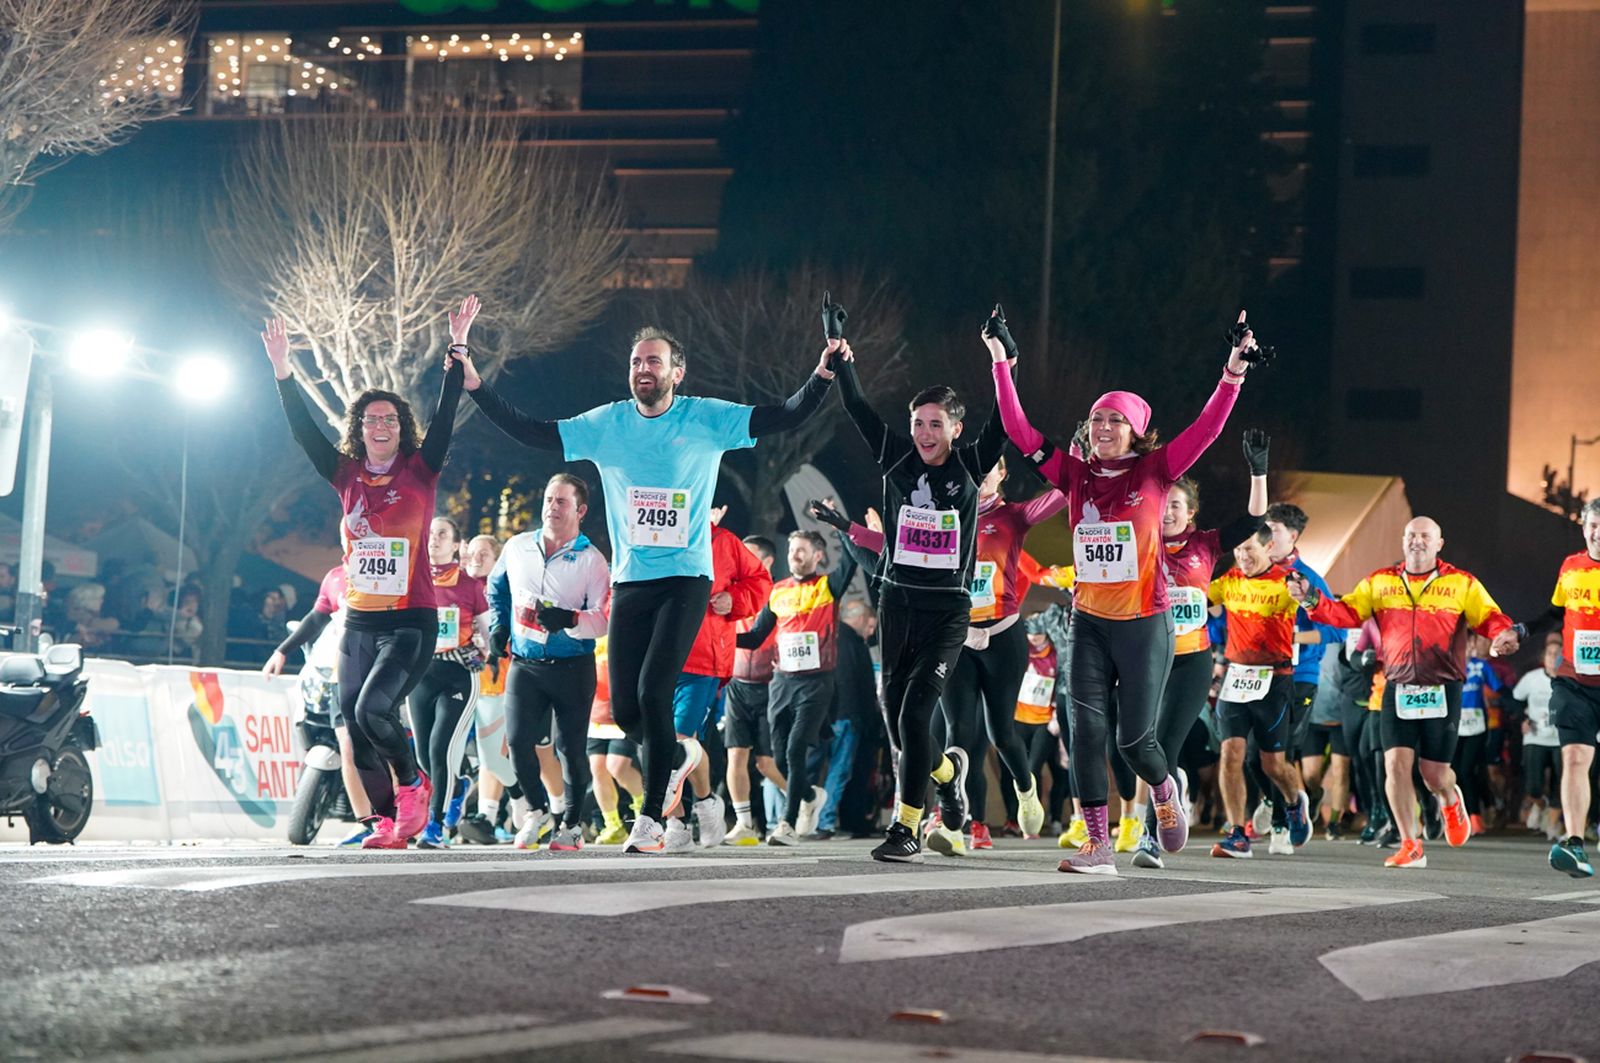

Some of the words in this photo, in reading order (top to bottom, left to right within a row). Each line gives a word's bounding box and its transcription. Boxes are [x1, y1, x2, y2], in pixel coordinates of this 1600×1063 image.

[637, 508, 677, 527] 2493
[905, 527, 951, 548] 14337
[1085, 544, 1123, 562] 5487
[359, 558, 397, 575] 2494
[1250, 593, 1280, 606] VIVA!
[1423, 586, 1456, 599] VIVA!
[1232, 678, 1262, 691] 4550
[1405, 692, 1436, 706] 2434
[245, 714, 290, 753] SAN
[104, 738, 150, 768] alsa
[214, 732, 247, 794] 43
[257, 761, 303, 799] ANT
